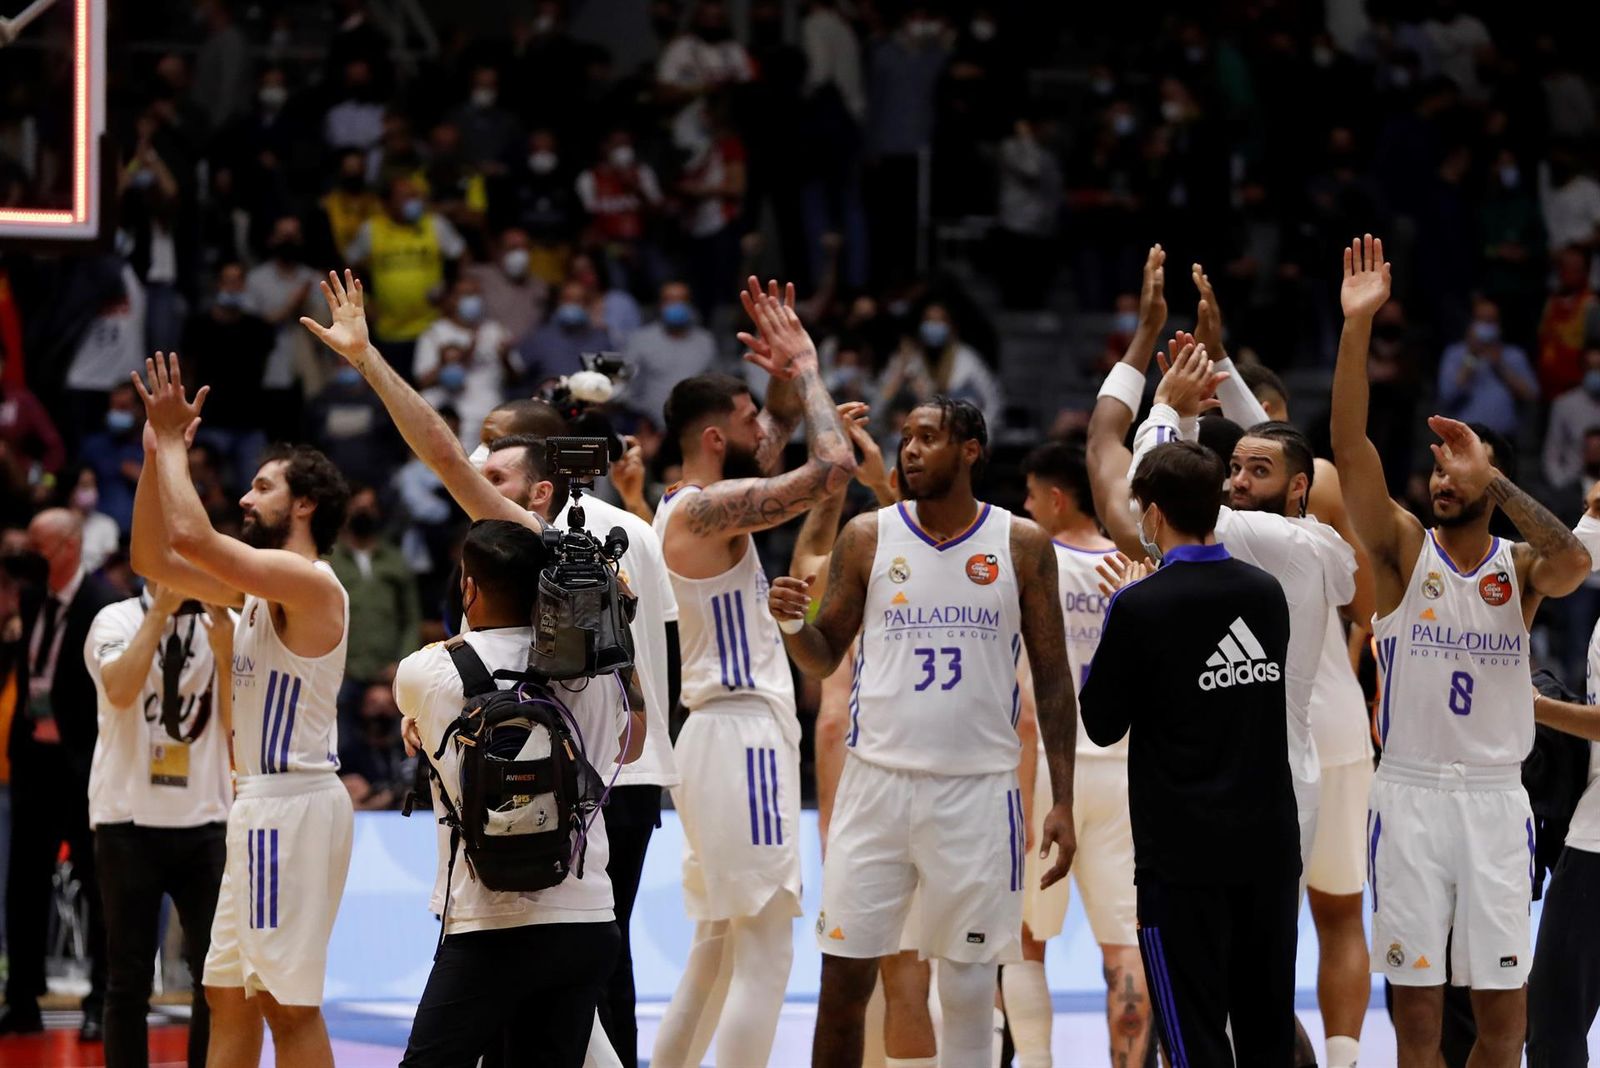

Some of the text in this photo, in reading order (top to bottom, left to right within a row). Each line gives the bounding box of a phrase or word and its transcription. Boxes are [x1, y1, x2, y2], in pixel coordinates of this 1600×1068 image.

[884, 605, 999, 627] PALLADIUM
[884, 630, 998, 641] HOTEL GROUP
[1410, 649, 1461, 660] HOTEL
[914, 647, 962, 691] 33
[1198, 659, 1281, 691] adidas
[1448, 670, 1474, 716] 8
